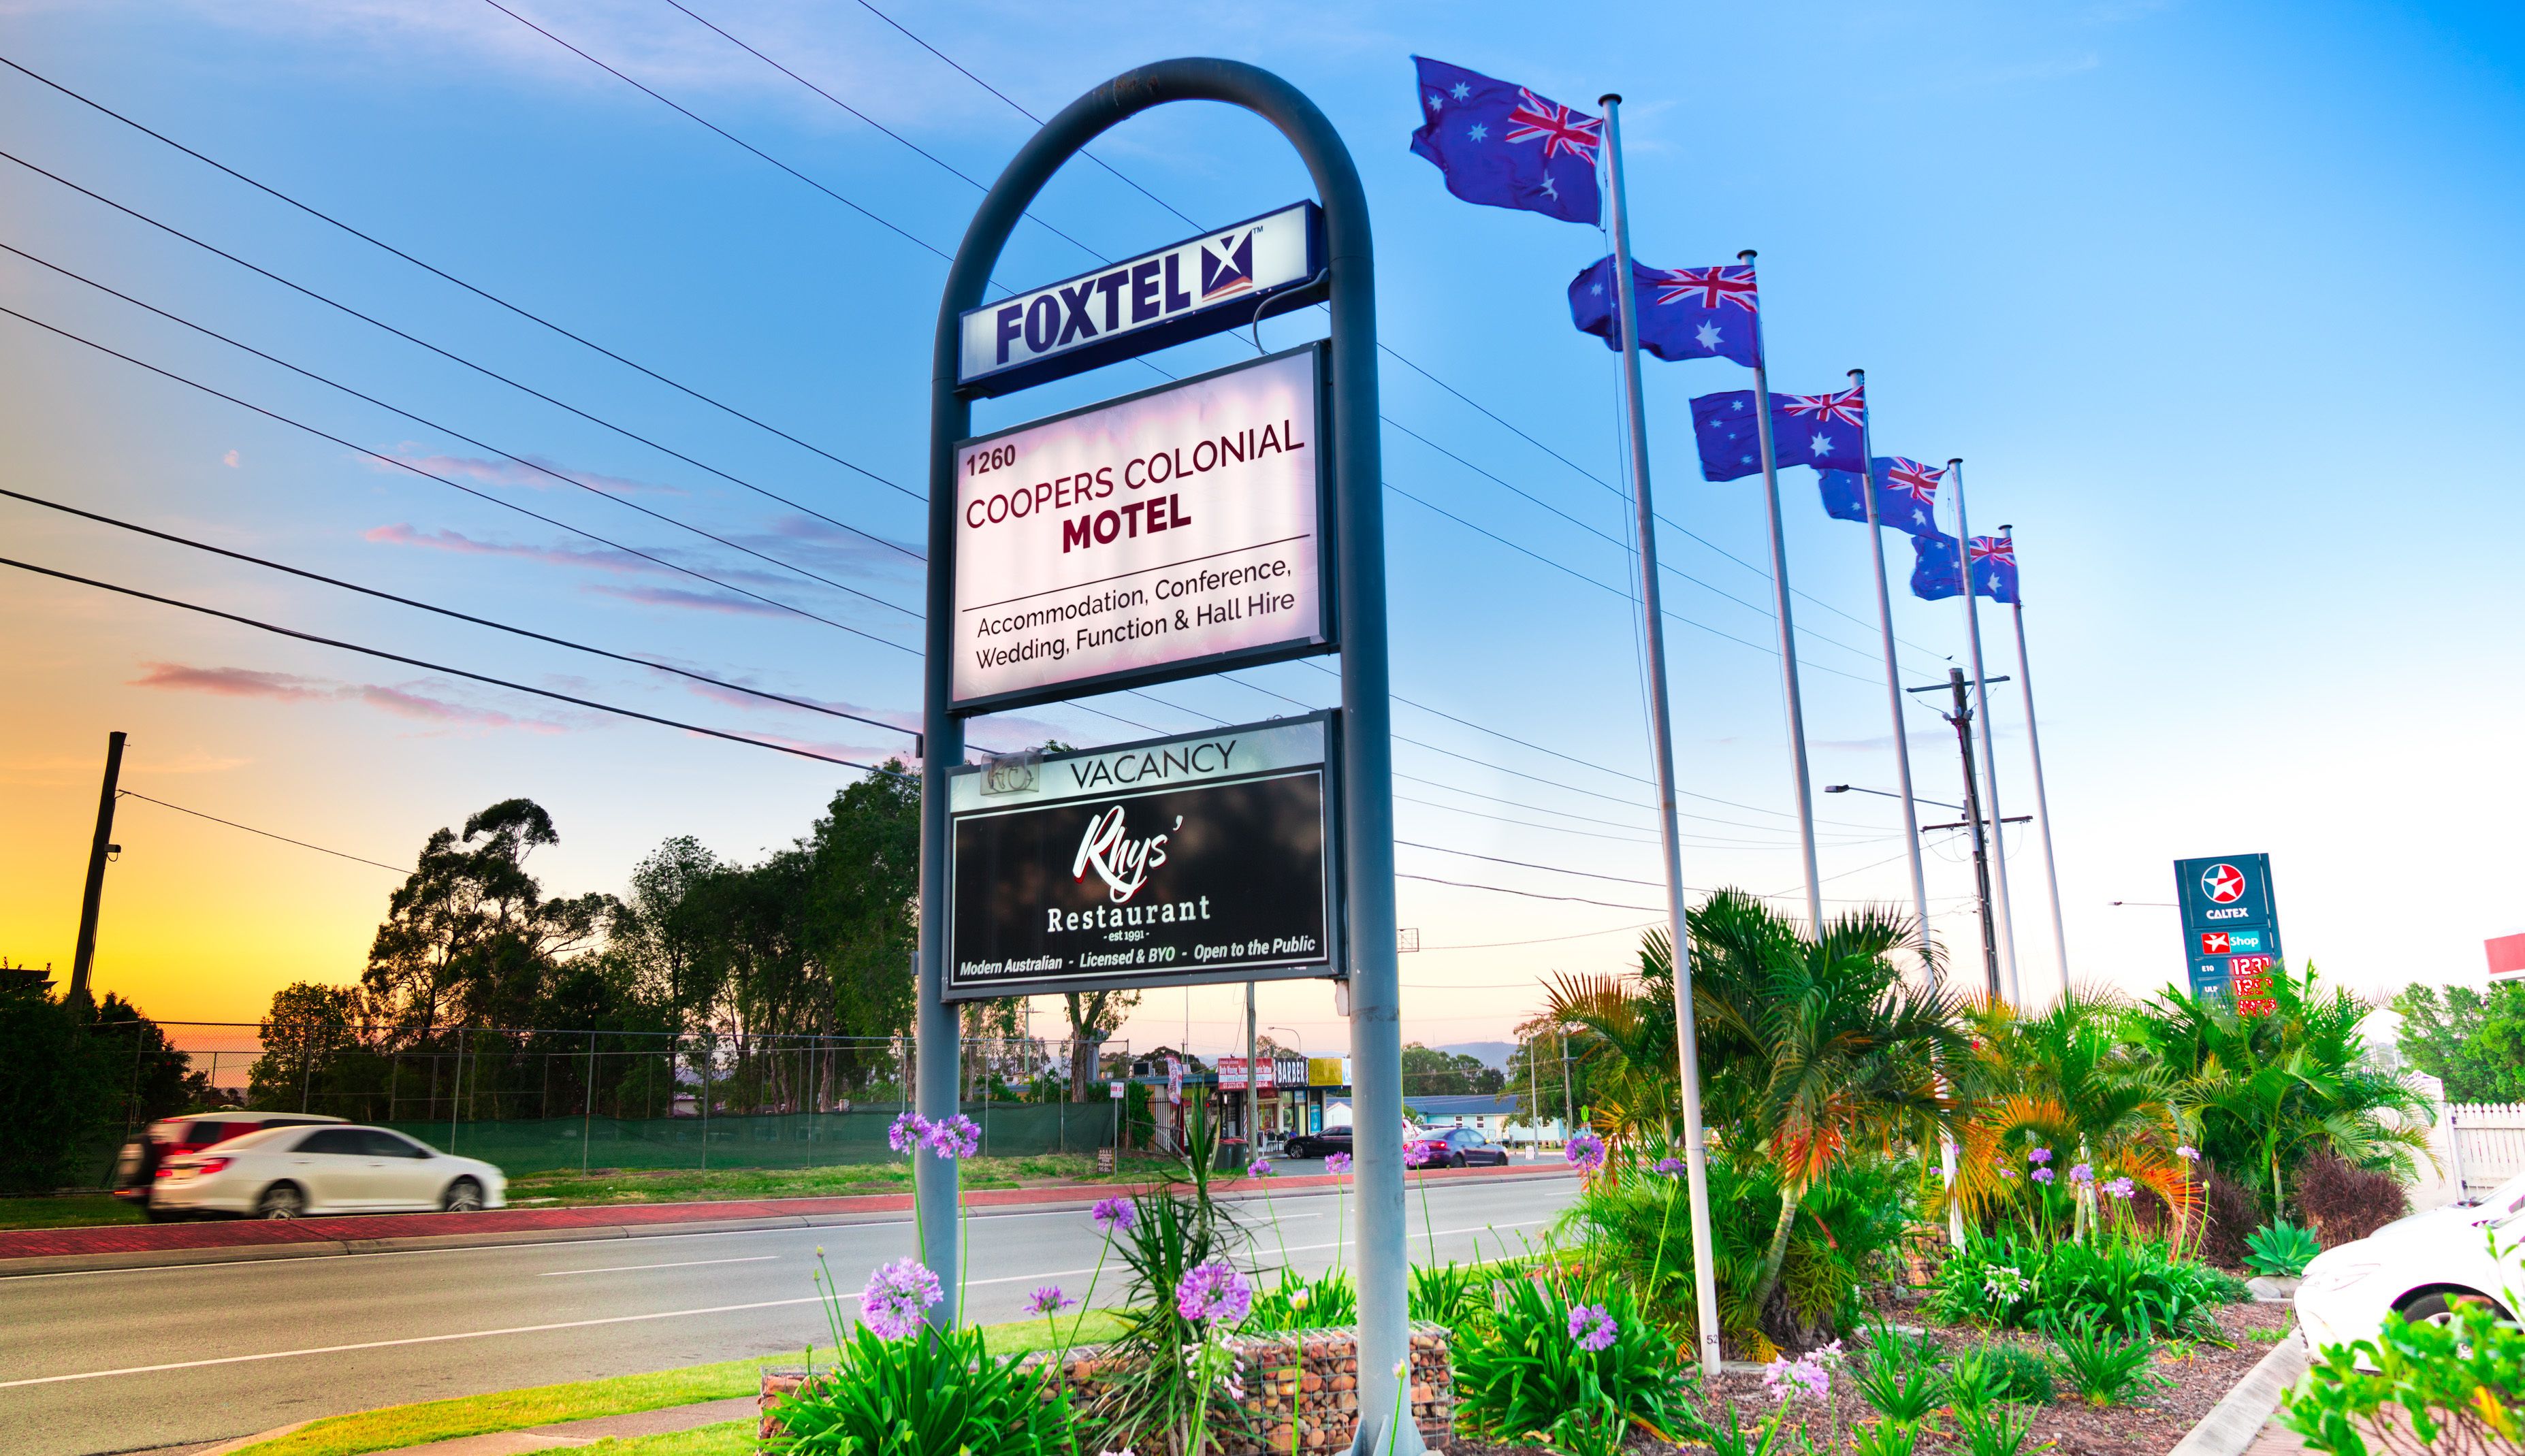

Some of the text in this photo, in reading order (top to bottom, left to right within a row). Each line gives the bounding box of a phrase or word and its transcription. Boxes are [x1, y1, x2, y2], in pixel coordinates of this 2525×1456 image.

[996, 253, 1191, 366] FOXTEL
[966, 419, 1305, 528] COOPERS COLONIAL
[967, 444, 1016, 476] 1260
[1063, 493, 1191, 554] MOTEL
[977, 560, 1291, 638] Accommodation, Conference,
[976, 592, 1295, 669] Wedding, Function & Hall Hire
[1070, 739, 1237, 790] VACANCY
[1047, 895, 1211, 933] Restaurant
[2206, 907, 2249, 920] CALTEX
[1125, 930, 1144, 941] 1991
[2230, 937, 2259, 948] Shop
[960, 960, 1003, 976] Modern
[1003, 955, 1063, 973] Australian
[1079, 949, 1134, 968] Licensed
[1136, 949, 1145, 964] &
[1148, 947, 1176, 963] BYO
[1194, 943, 1229, 962] Open
[1231, 942, 1244, 957] to
[1247, 939, 1270, 956] the
[1272, 935, 1316, 954] Public
[1277, 1061, 1305, 1083] BARBER
[1707, 1334, 1718, 1344] 52
